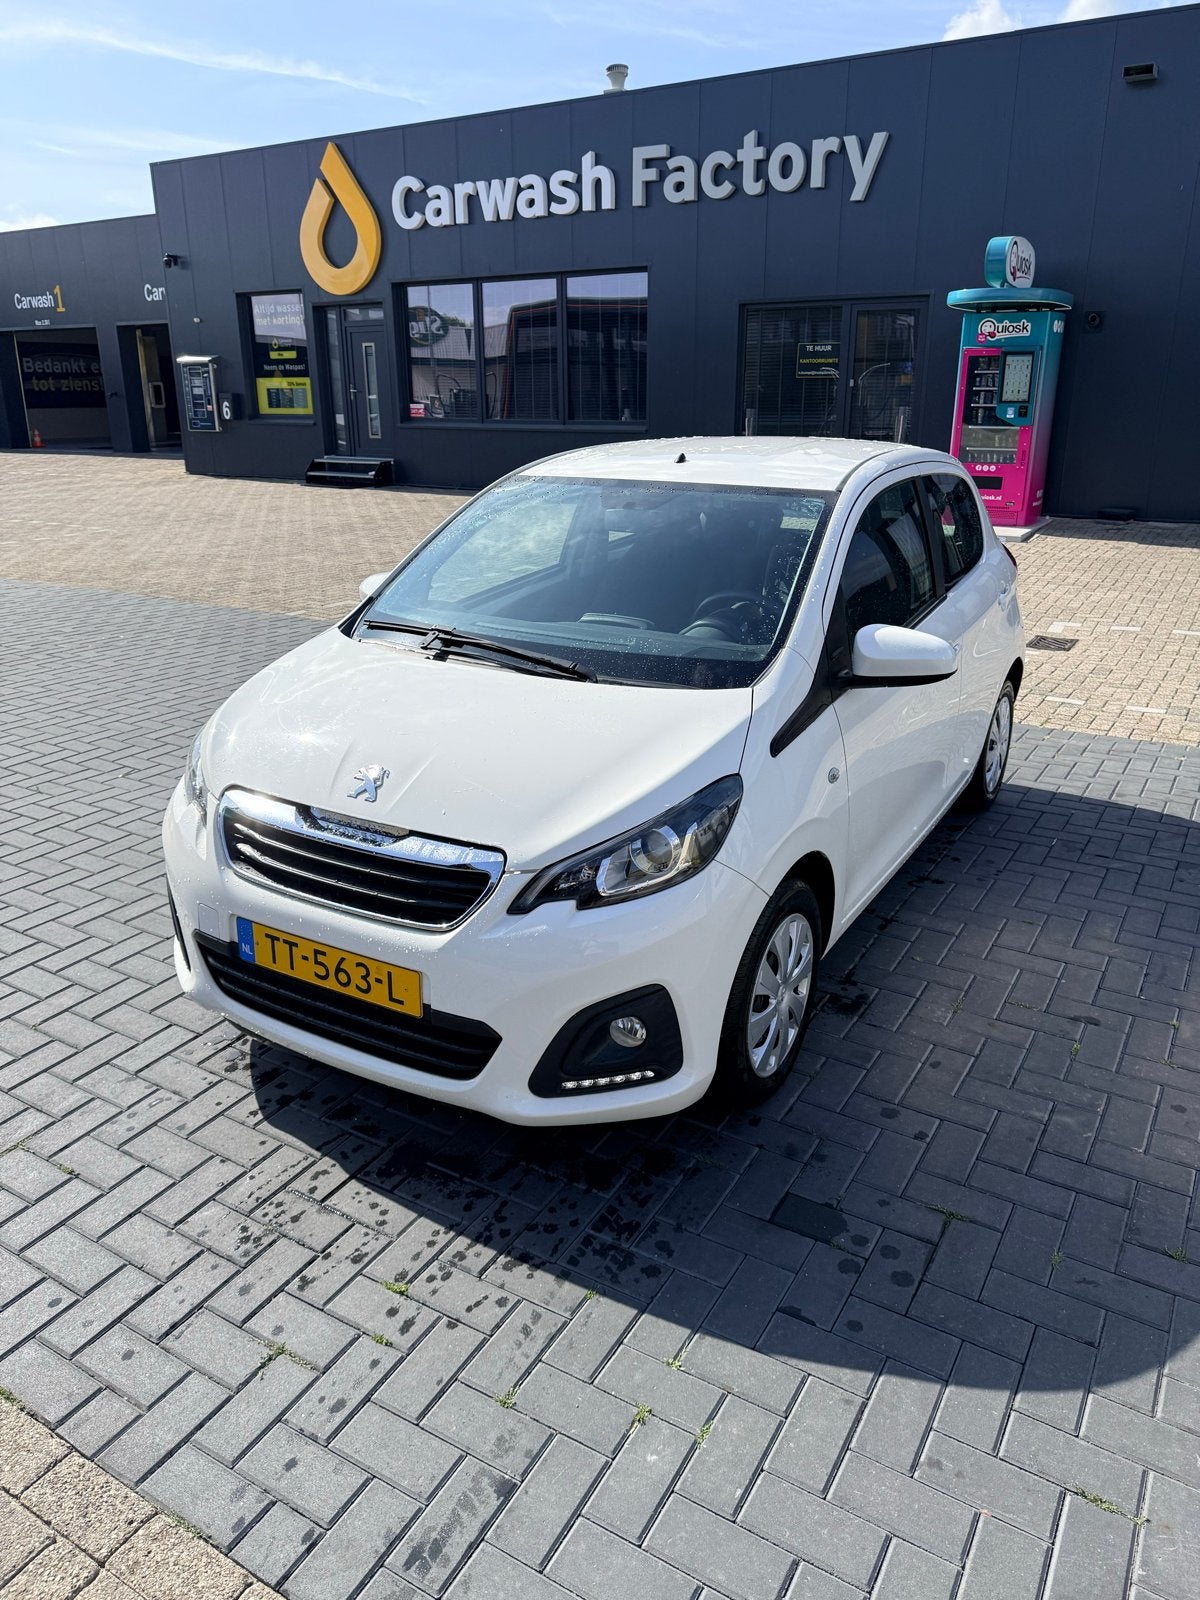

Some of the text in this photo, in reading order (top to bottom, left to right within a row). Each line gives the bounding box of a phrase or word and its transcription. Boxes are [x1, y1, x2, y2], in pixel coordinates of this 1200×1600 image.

[391, 129, 890, 231] Carwash Factory
[1009, 240, 1032, 282] Quiosk
[14, 285, 65, 312] Carwash 1
[979, 318, 1030, 339] Quiosk
[22, 356, 86, 373] Bedankt
[32, 376, 56, 391] tot
[222, 401, 231, 420] 6
[241, 932, 405, 1006] NL TT-563-L
